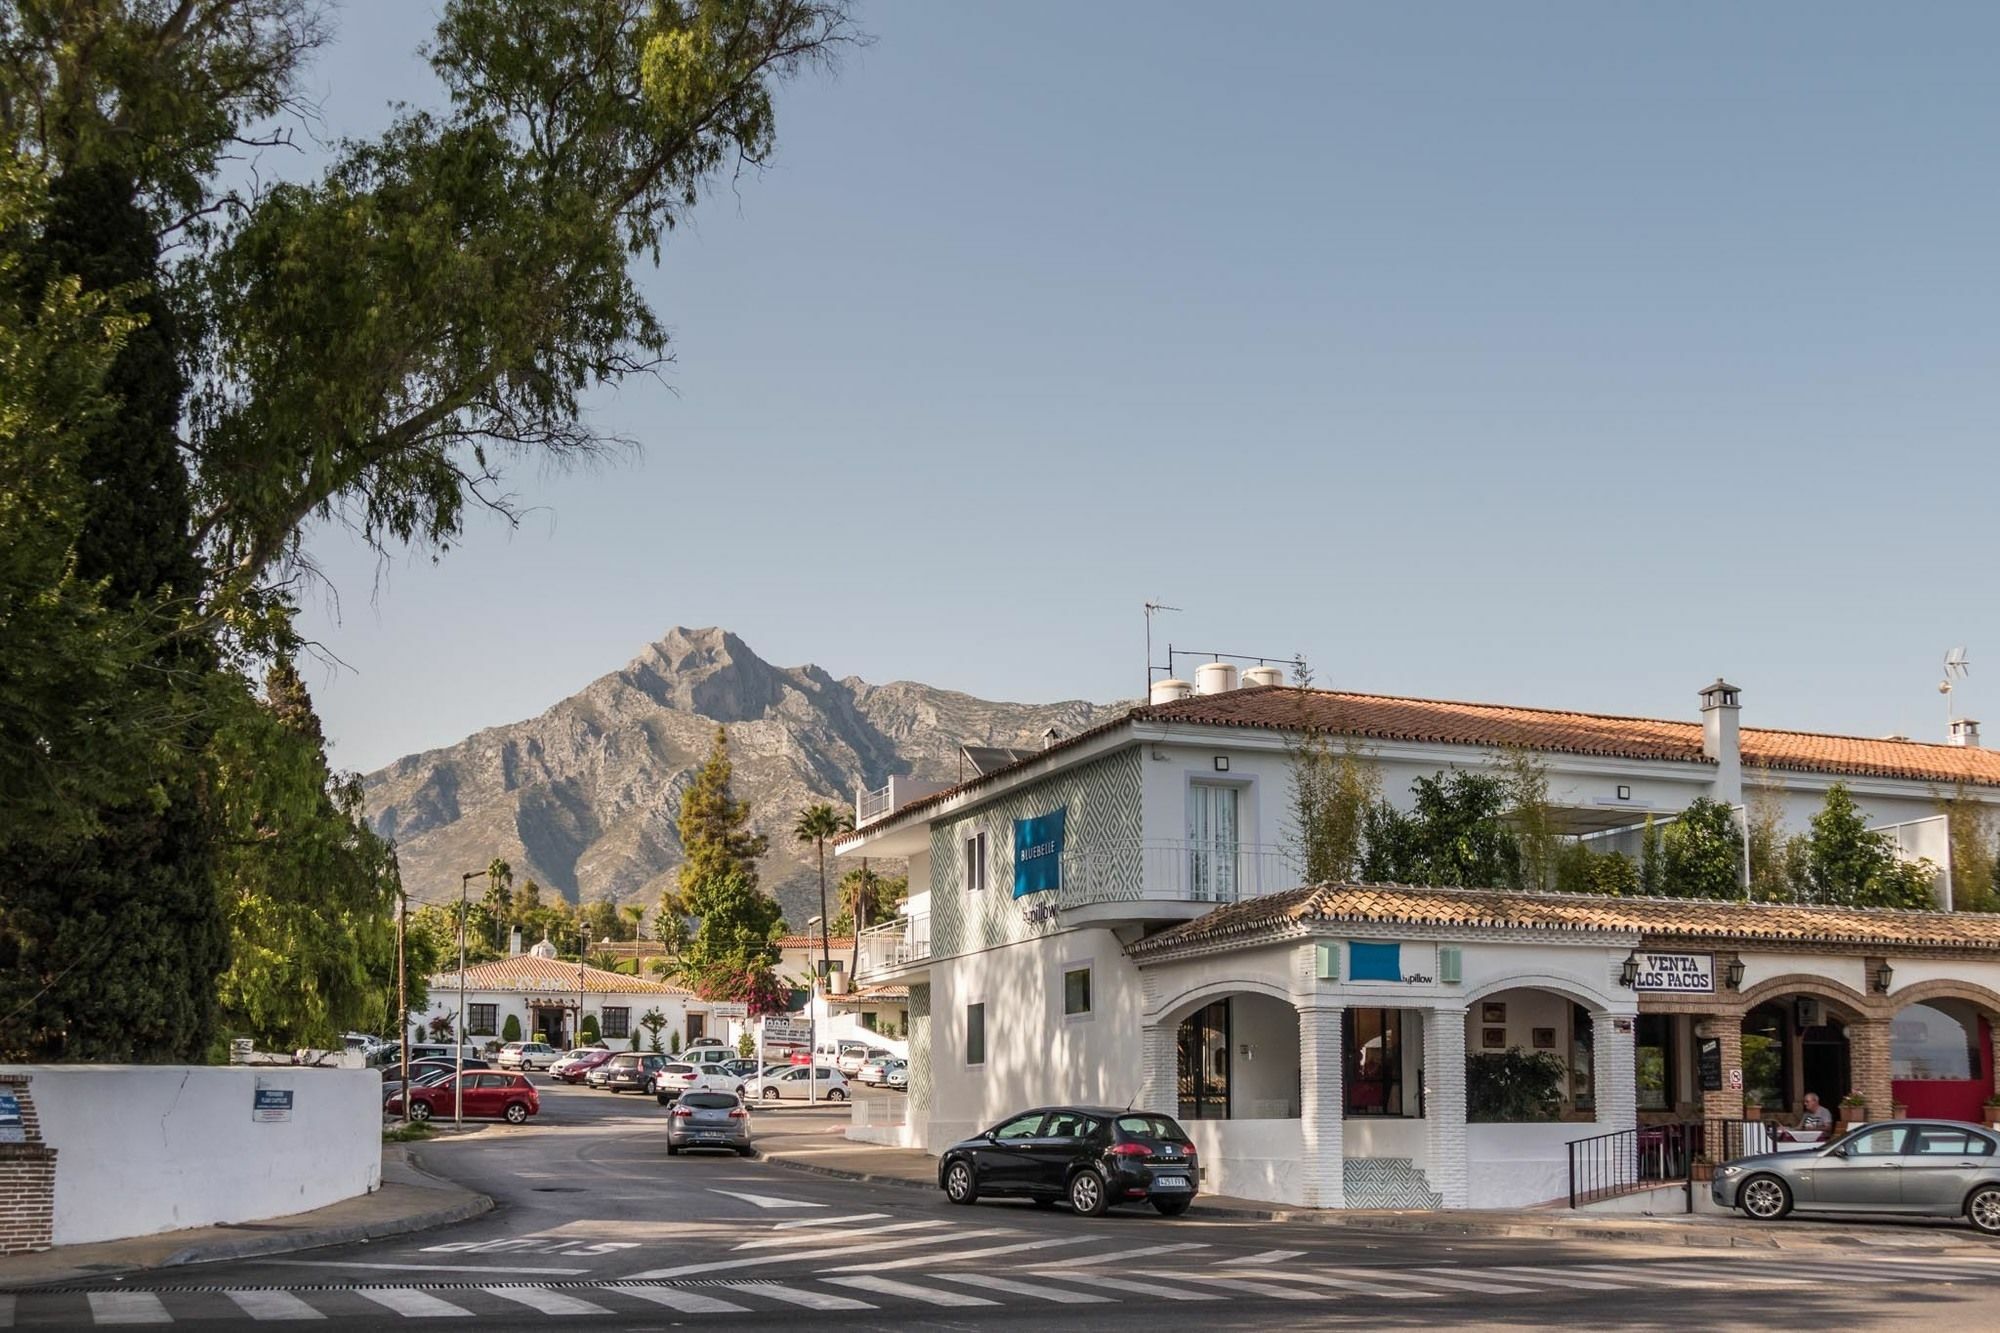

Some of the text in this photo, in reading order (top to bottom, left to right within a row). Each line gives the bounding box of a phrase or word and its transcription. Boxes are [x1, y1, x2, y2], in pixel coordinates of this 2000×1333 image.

[1020, 840, 1055, 862] BLUEBELLE
[1647, 955, 1699, 972] VENTA
[1636, 972, 1709, 988] LOS PACOS
